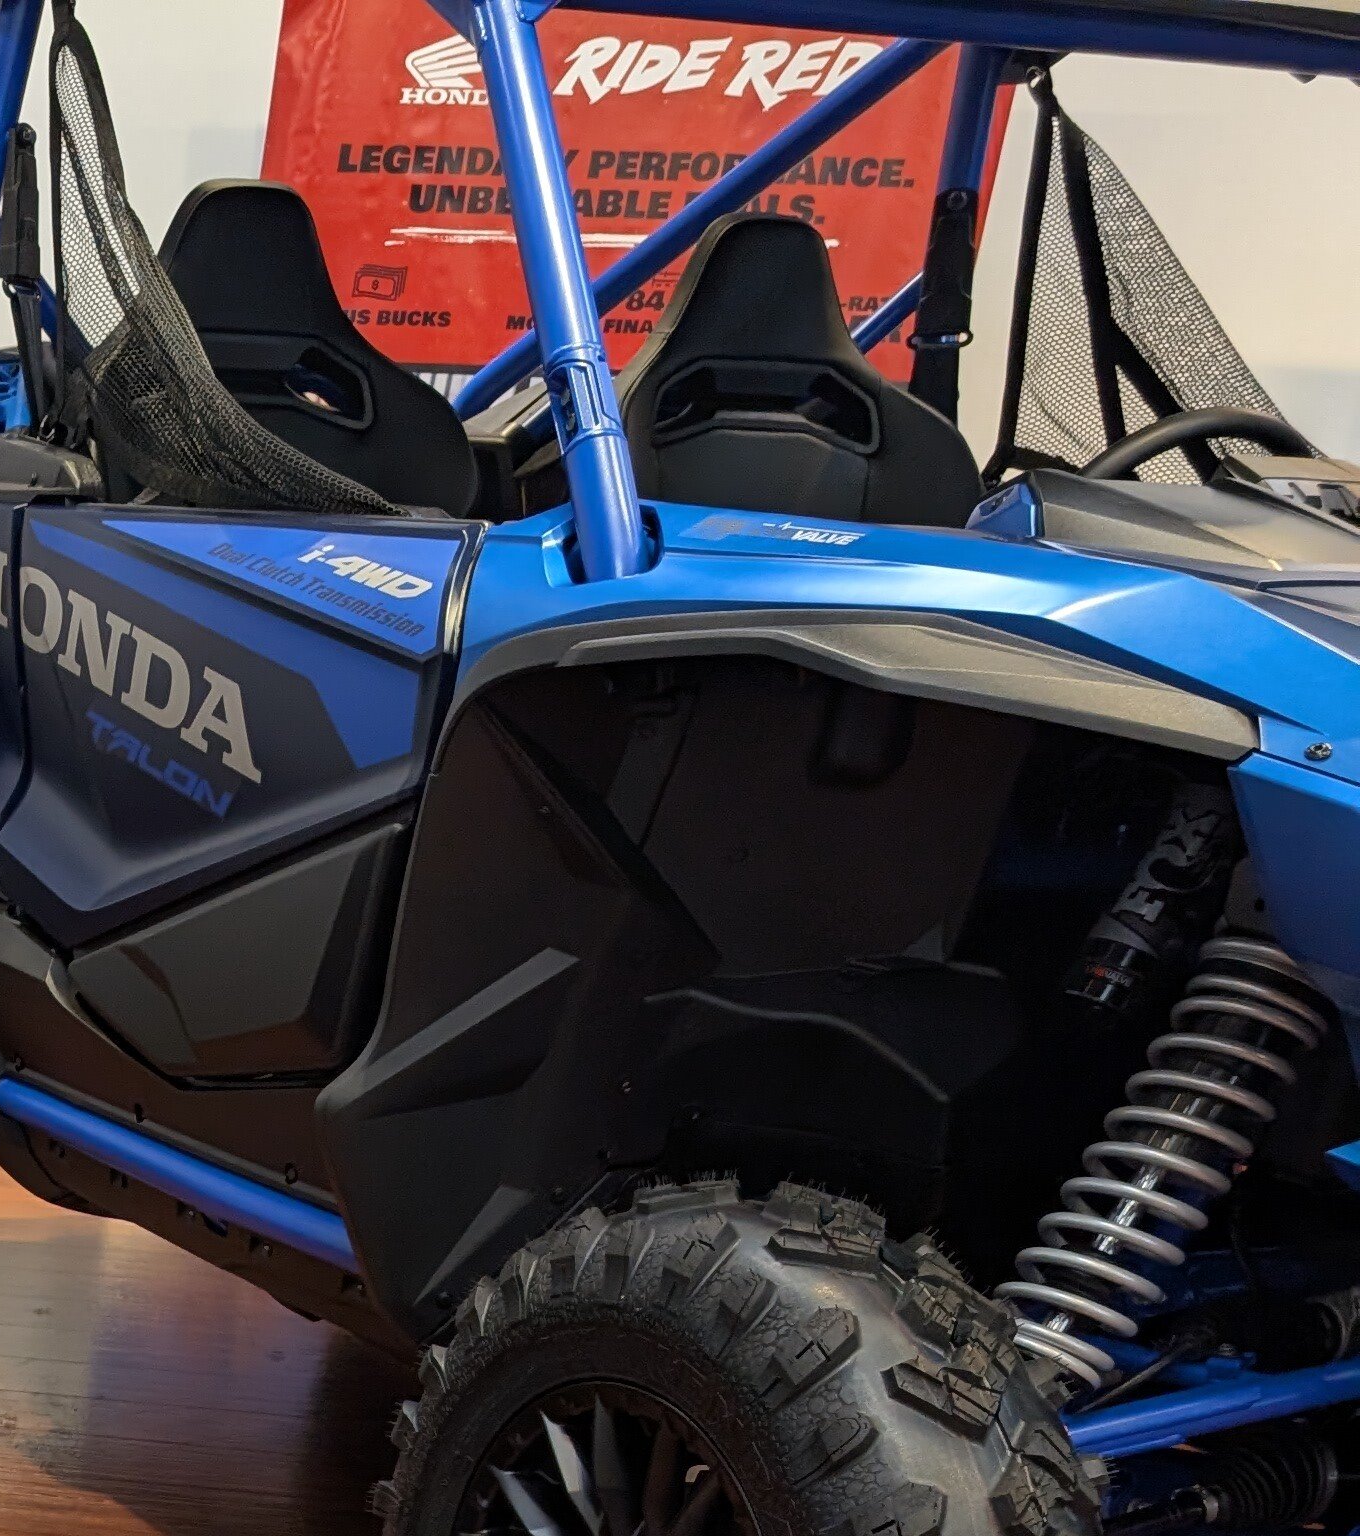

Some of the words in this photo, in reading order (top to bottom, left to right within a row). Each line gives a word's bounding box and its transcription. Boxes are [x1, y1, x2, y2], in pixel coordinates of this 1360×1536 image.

[399, 87, 489, 106] HOND
[553, 36, 733, 105] RIDE
[723, 36, 886, 112] RED
[376, 310, 452, 328] BUCKS
[790, 529, 860, 546] VALVE
[207, 542, 248, 566] Dual
[245, 553, 307, 588] Clutch
[299, 575, 426, 638] Transmission
[297, 543, 434, 599] i-4WD
[86, 709, 236, 819] TALON
